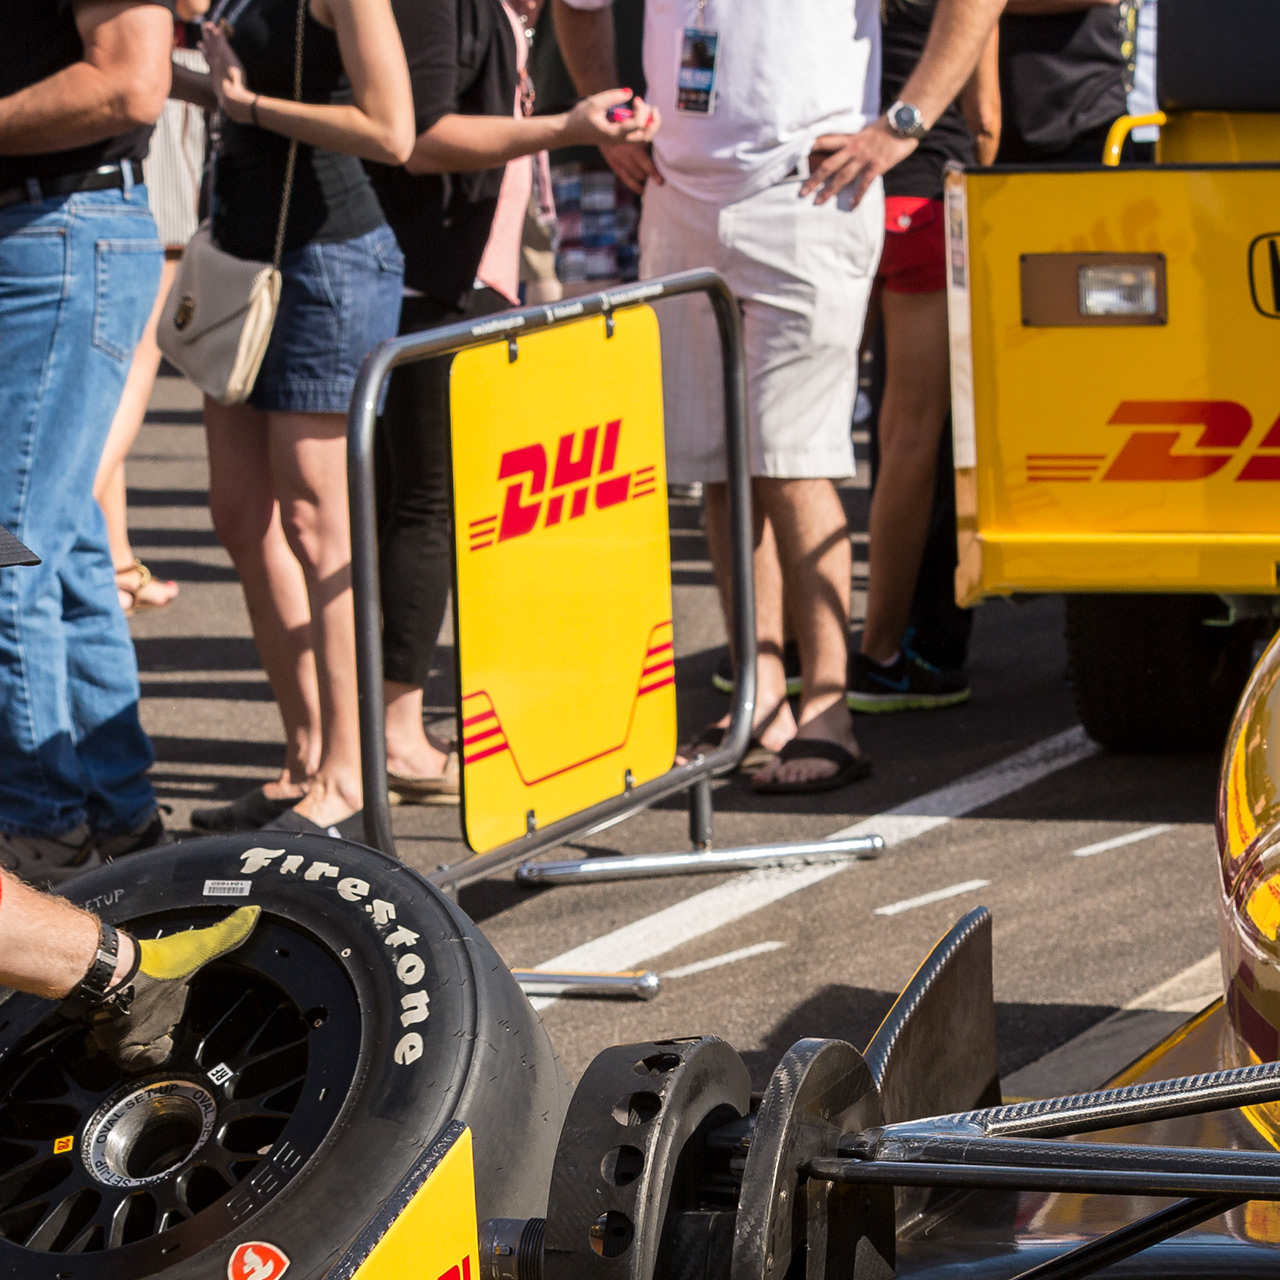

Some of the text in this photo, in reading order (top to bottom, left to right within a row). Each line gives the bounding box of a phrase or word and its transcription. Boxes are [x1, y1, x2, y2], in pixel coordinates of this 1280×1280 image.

[497, 418, 632, 543] DHL
[240, 847, 431, 1066] Firestone
[96, 1084, 179, 1144] OVAL SET-UP
[192, 1089, 213, 1119] OVAL
[57, 1137, 71, 1151] 28
